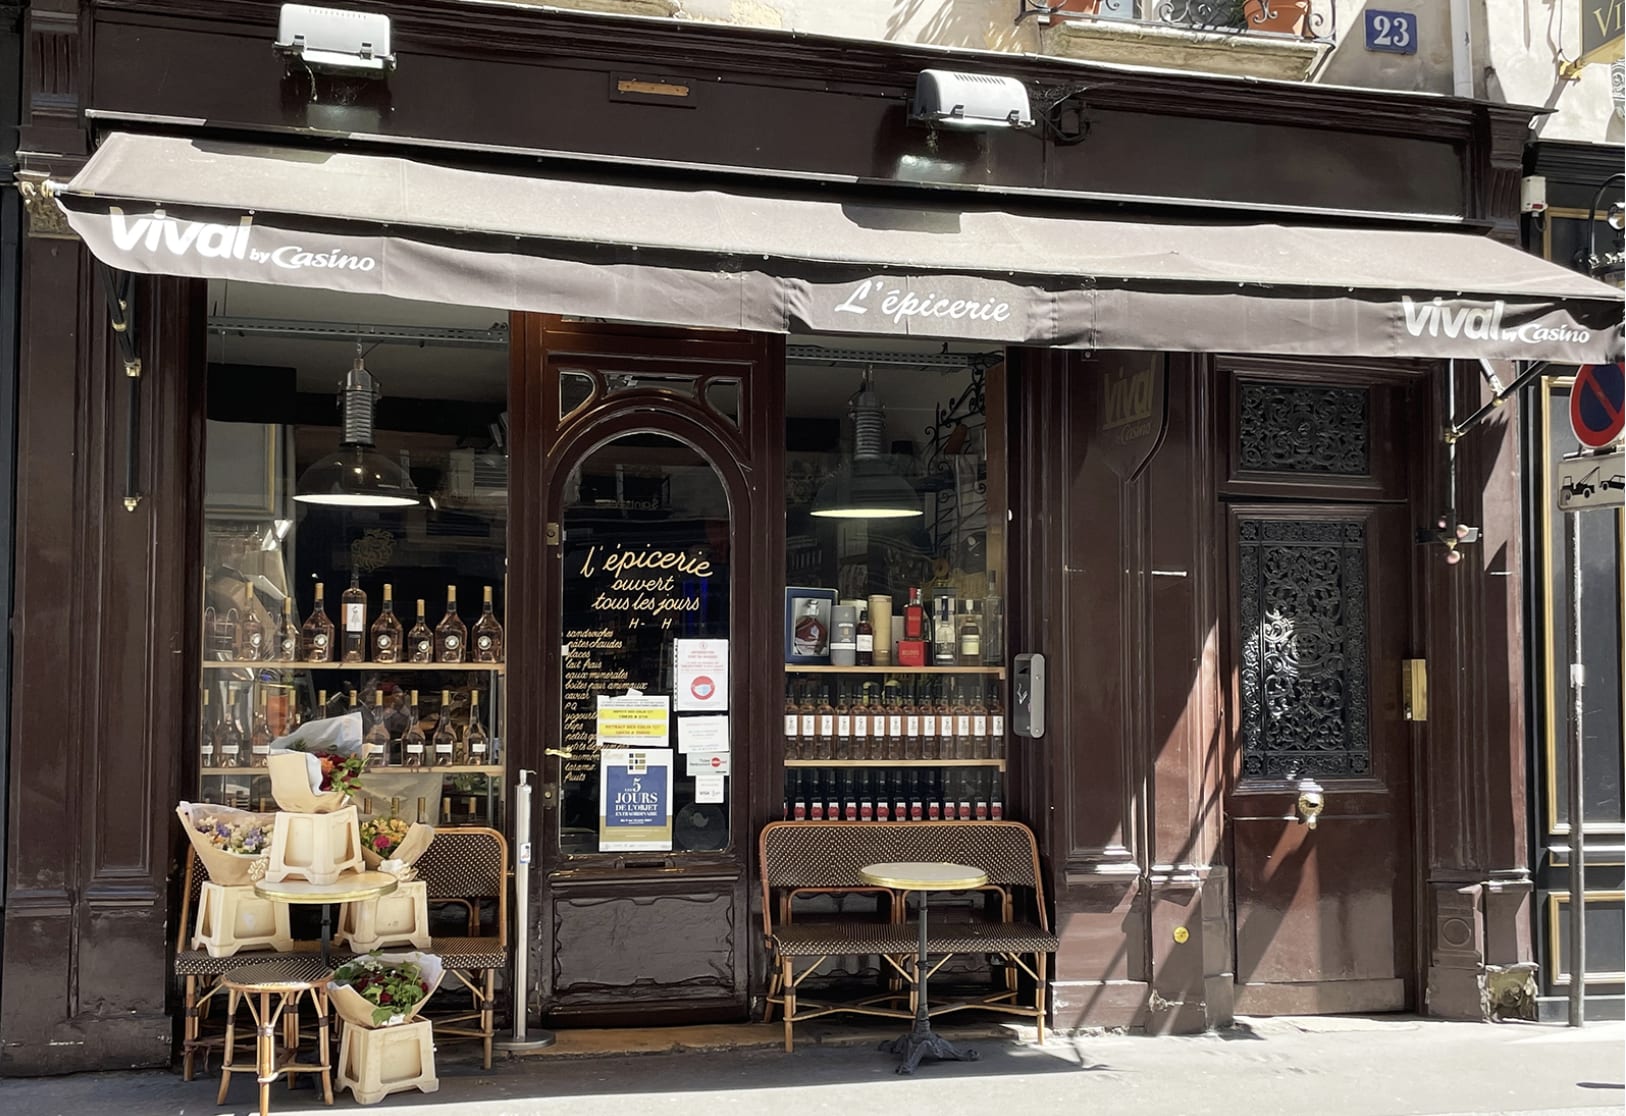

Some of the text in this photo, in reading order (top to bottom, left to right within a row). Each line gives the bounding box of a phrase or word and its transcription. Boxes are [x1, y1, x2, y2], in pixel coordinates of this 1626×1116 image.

[1373, 15, 1410, 47] 23
[249, 248, 271, 264] by
[271, 245, 376, 272] Casino
[1518, 322, 1591, 344] Casino
[611, 575, 675, 591] ouvert
[591, 592, 700, 616] tous les jours
[589, 637, 623, 649] chaudes
[565, 659, 581, 669] lait
[607, 682, 649, 690] animaux
[632, 776, 642, 792] 5
[615, 792, 658, 804] JOURS
